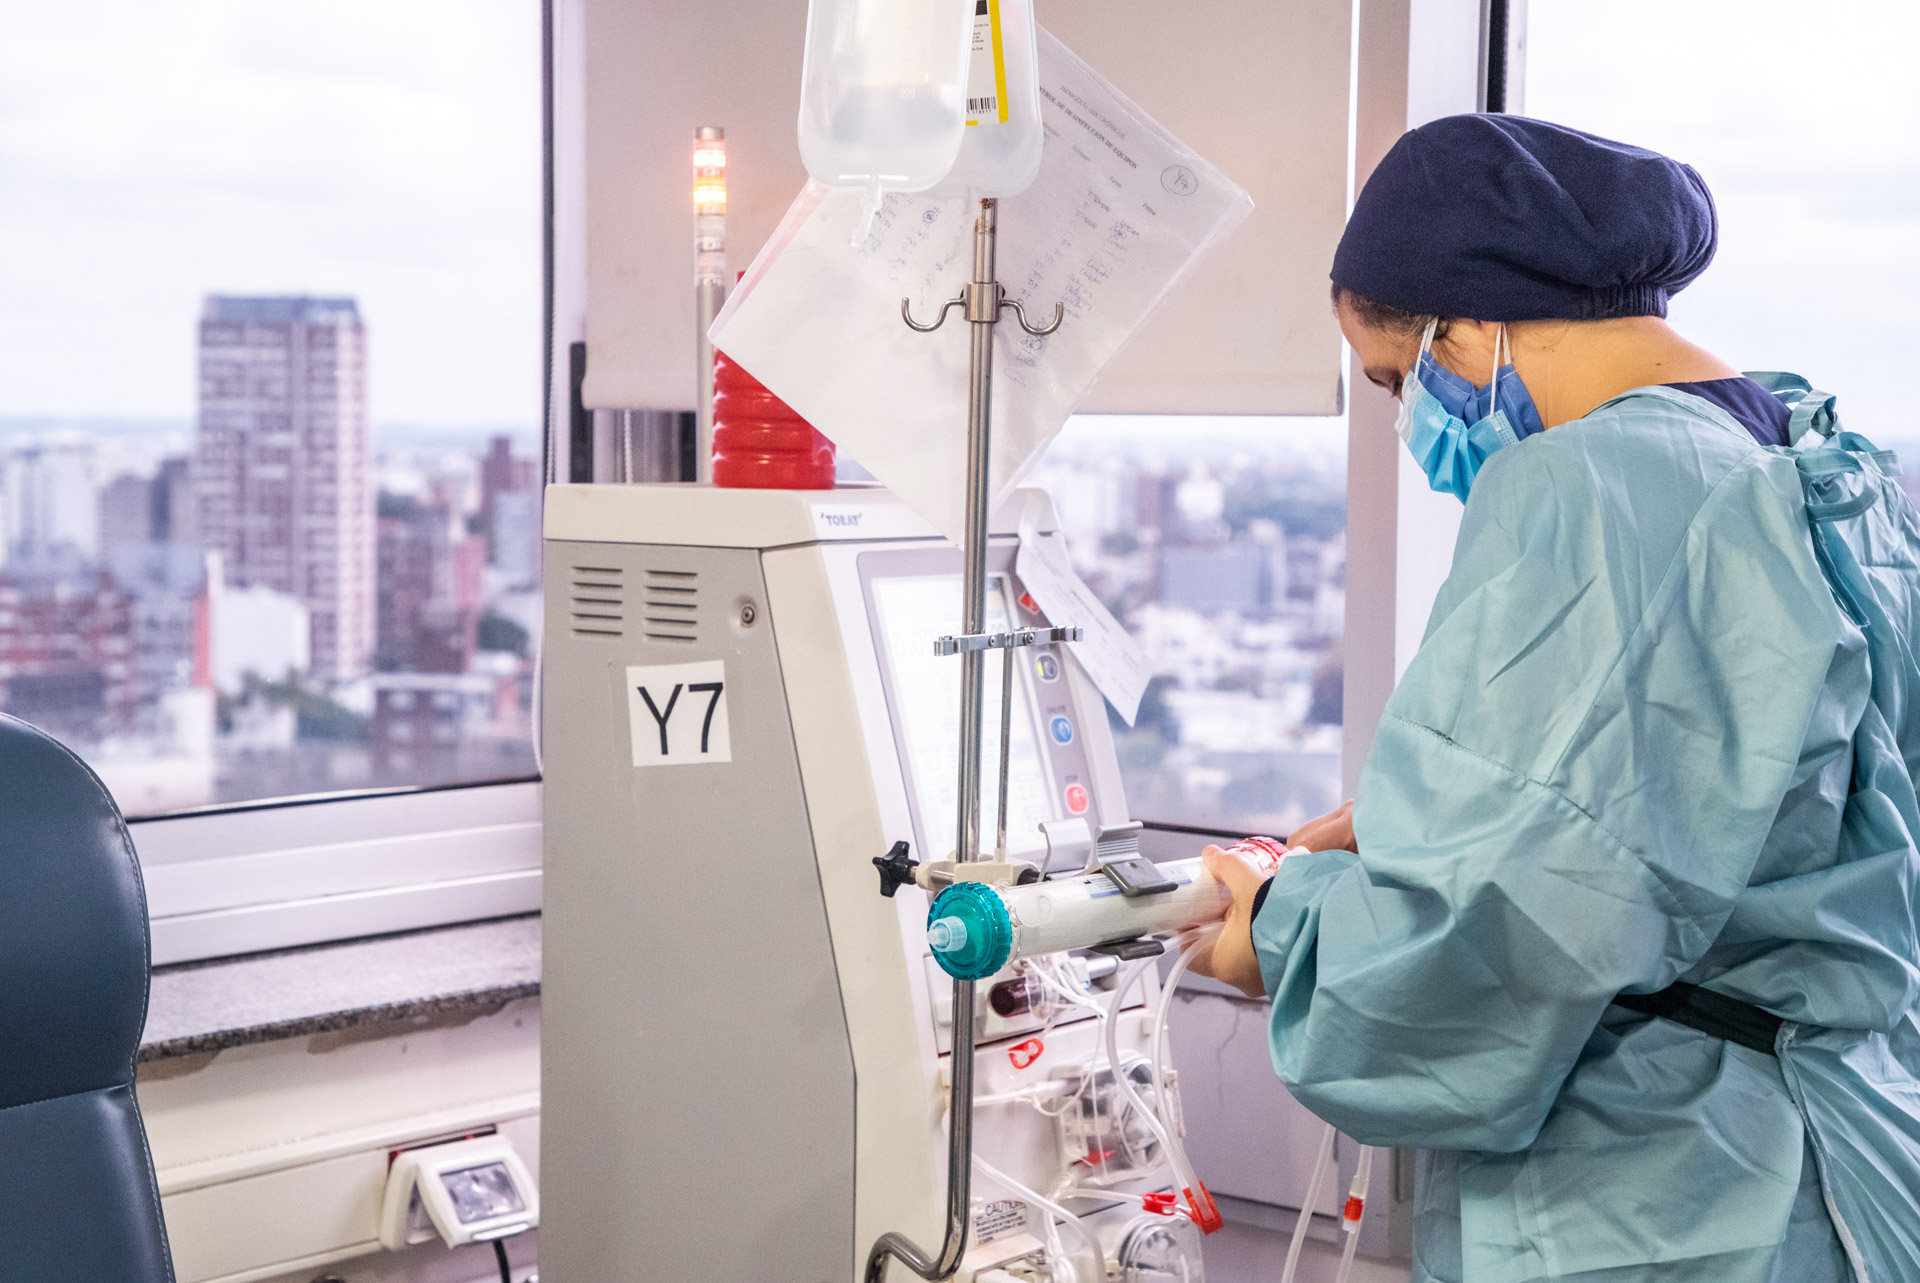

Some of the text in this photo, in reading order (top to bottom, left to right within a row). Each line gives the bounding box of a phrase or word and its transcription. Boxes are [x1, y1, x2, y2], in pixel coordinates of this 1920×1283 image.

[1056, 101, 1065, 111] DE
[1104, 140, 1114, 150] DE
[1112, 147, 1137, 169] EQUIPOS
[636, 682, 725, 756] Y7
